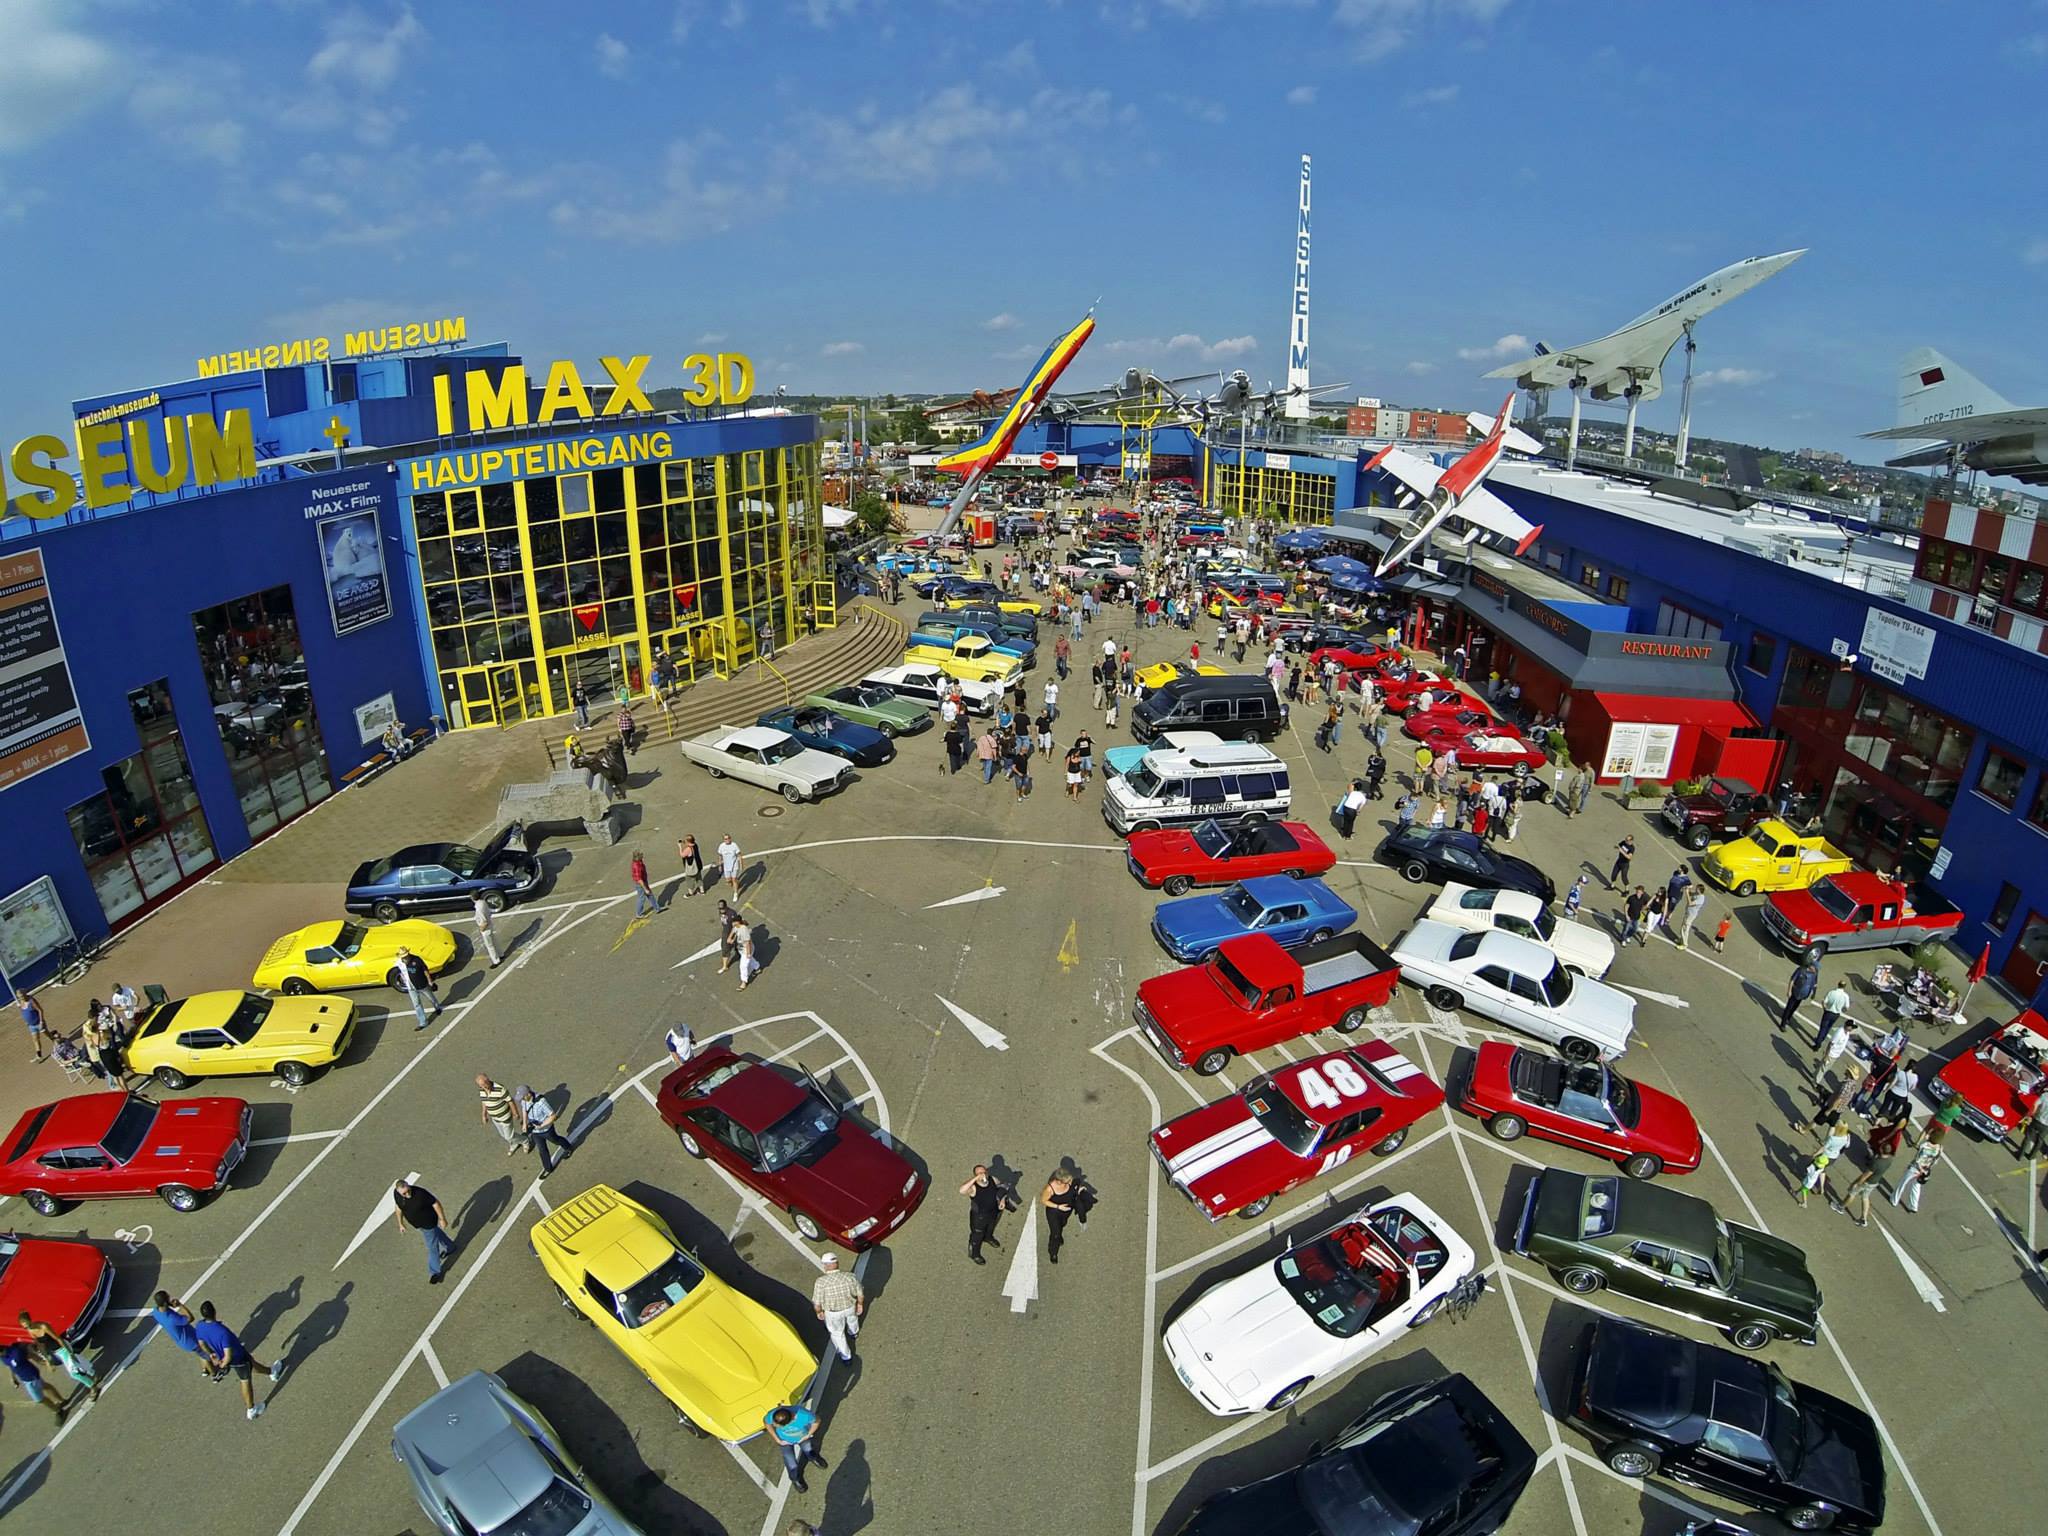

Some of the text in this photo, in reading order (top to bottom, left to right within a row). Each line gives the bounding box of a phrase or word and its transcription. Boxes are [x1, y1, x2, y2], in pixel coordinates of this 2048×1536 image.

[1293, 161, 1311, 370] SINSHEIM
[1659, 283, 1707, 315] AIR FRANCE
[433, 352, 755, 436] IMAX 3D
[0, 407, 257, 521] SEUM
[411, 430, 673, 491] HAUPTEINGANG
[312, 481, 371, 500] Neuester
[304, 499, 344, 519] IMAX
[351, 494, 381, 509] Film:
[675, 610, 700, 624] KASSE
[1902, 621, 1925, 637] TU-144
[576, 631, 606, 644] KASSE
[1621, 640, 1713, 660] RESTAURANT
[1208, 802, 1233, 813] CYCLES
[1297, 1058, 1368, 1110] 48
